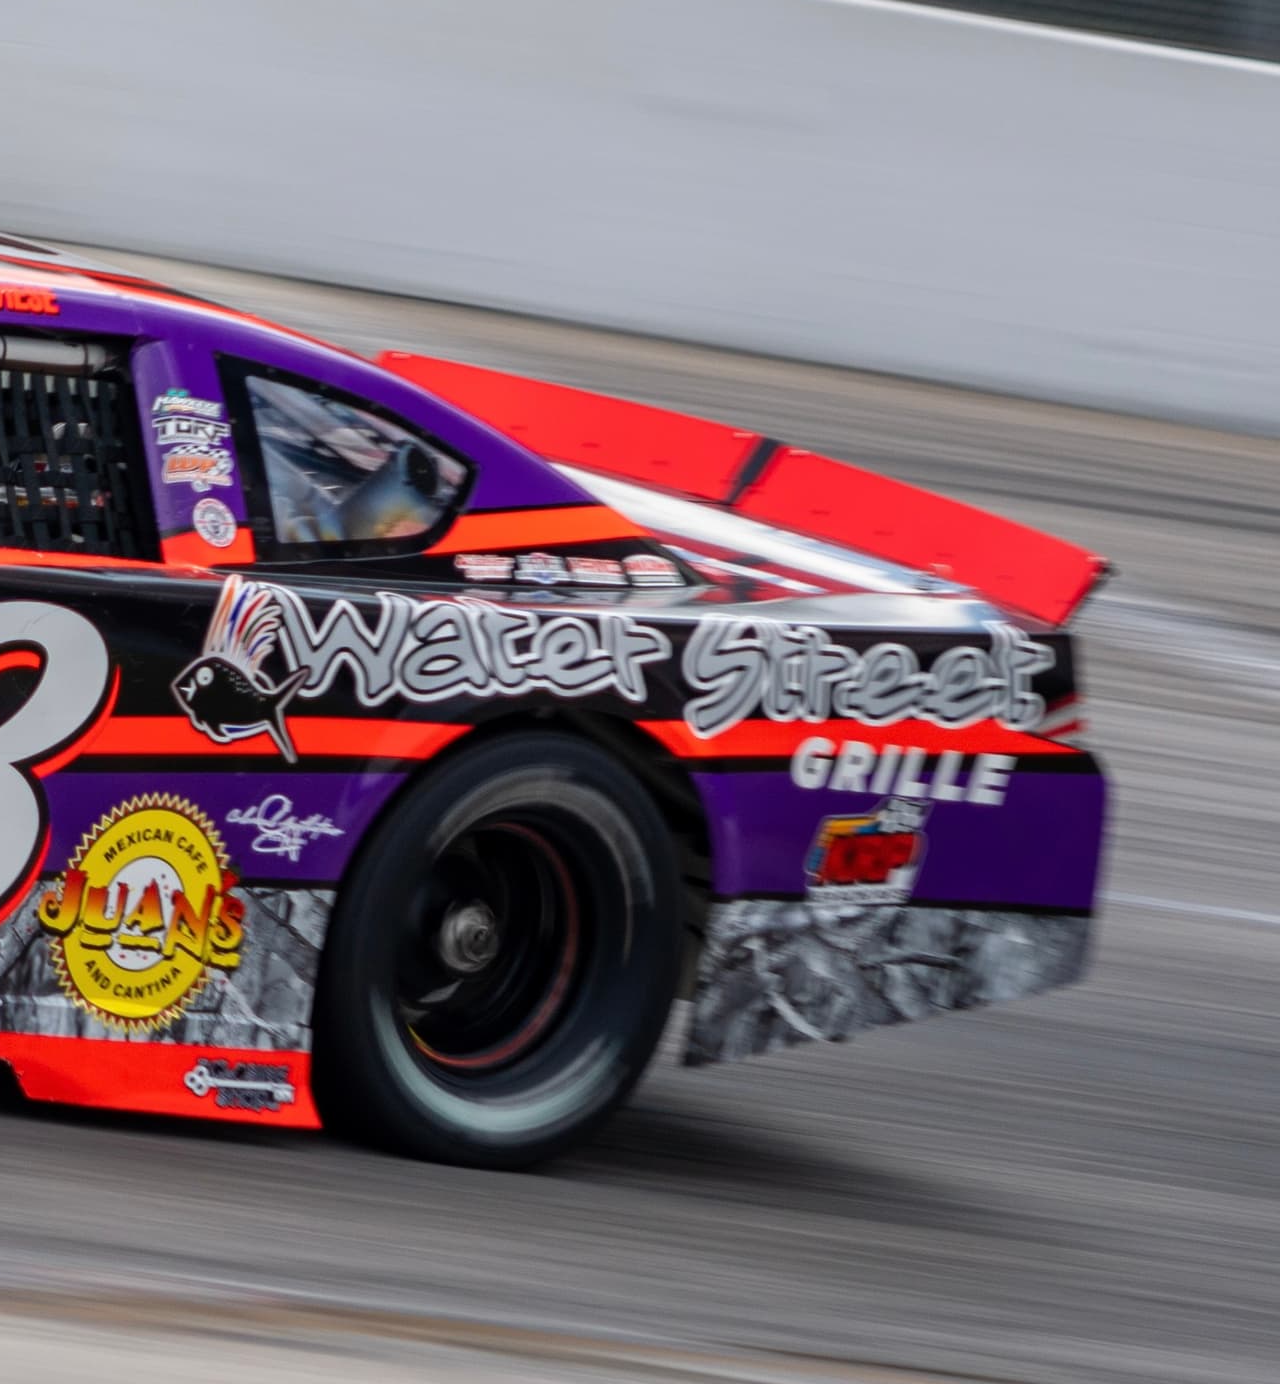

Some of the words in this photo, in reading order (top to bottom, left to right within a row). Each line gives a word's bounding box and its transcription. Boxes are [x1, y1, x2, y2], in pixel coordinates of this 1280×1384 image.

[272, 586, 671, 707] Water
[683, 614, 1056, 738] Street
[791, 735, 1018, 807] GRILLE
[102, 829, 174, 864] MEXICAN
[175, 832, 208, 874] CAFE
[84, 958, 110, 990] AND
[112, 965, 181, 999] CANTINA
